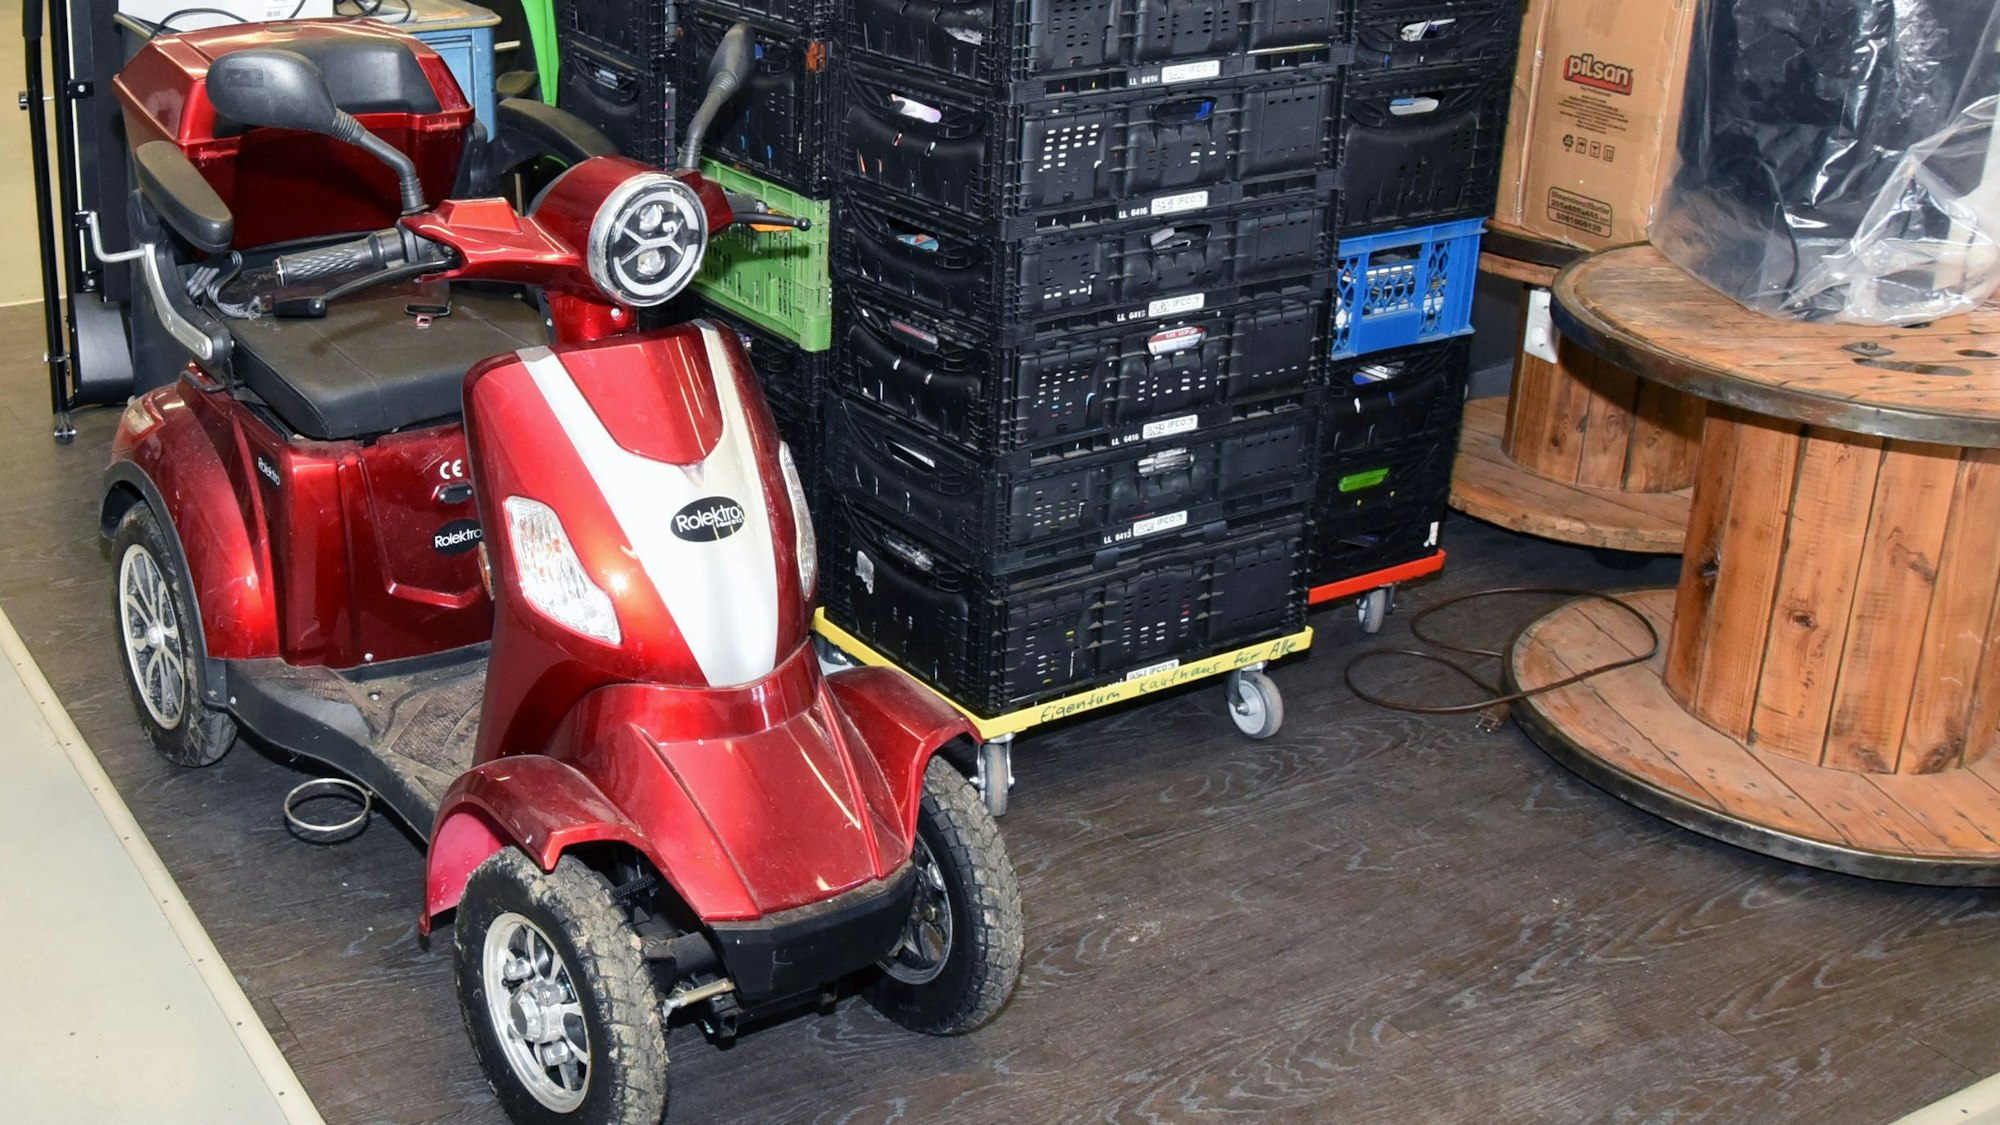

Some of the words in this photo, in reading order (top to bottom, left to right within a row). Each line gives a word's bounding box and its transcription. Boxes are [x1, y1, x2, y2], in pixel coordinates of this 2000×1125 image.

[1567, 53, 1631, 88] pilsan
[1176, 195, 1195, 205] IFCO
[1131, 207, 1148, 217] 6416
[1173, 298, 1192, 307] IFCO
[1168, 419, 1187, 429] IFCO
[1111, 438, 1120, 446] LL
[1123, 433, 1140, 443] 6416
[258, 456, 281, 486] Rolektro
[439, 459, 463, 480] CE
[675, 504, 740, 533] Rolektro
[1157, 516, 1176, 526] IFCO
[434, 528, 483, 549] Rolektro
[1103, 536, 1112, 545] LL
[1040, 692, 1120, 723] Eigentum
[1138, 661, 1221, 695] Kaufhaus
[1233, 651, 1259, 667] für
[1269, 639, 1297, 659] Alle
